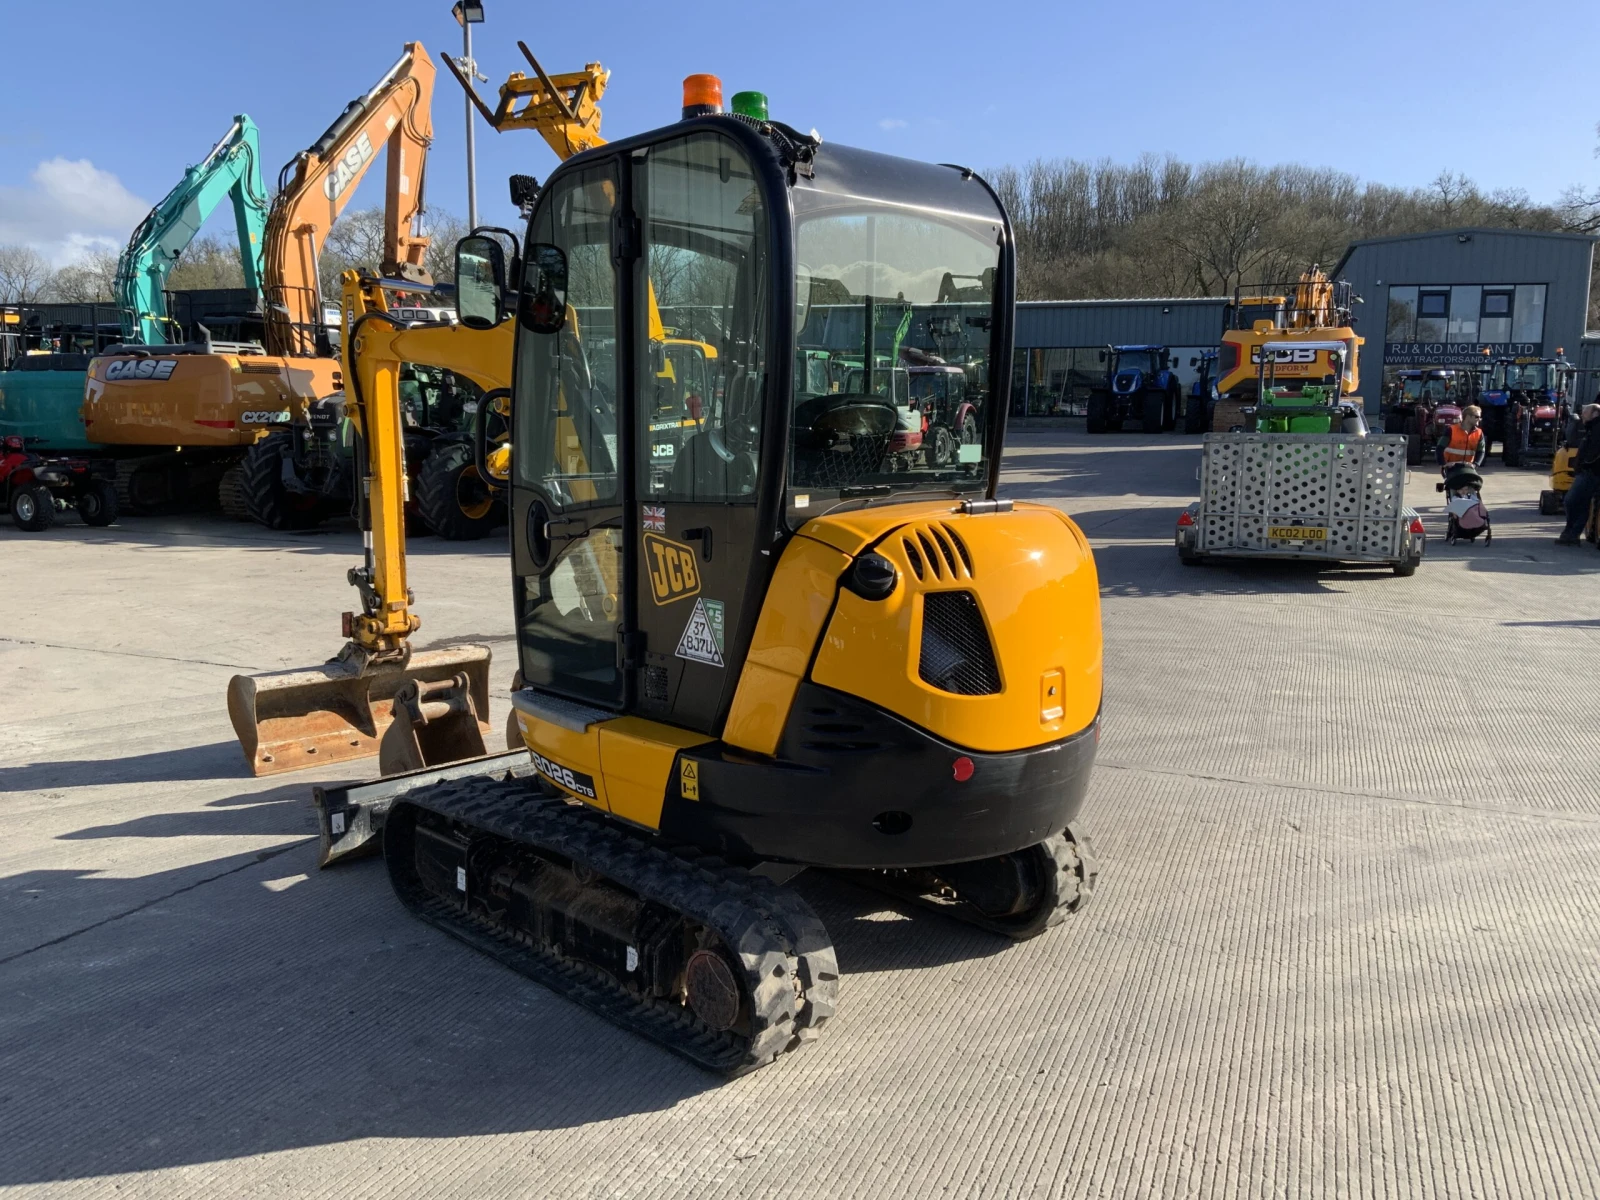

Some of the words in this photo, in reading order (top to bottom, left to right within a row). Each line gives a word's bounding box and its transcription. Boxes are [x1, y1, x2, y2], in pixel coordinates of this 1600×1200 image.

[323, 131, 373, 201] CASE
[1391, 344, 1408, 354] RJ
[1411, 344, 1420, 354] &
[1424, 344, 1443, 354] KD
[1447, 344, 1504, 354] MCLEAN
[1508, 344, 1534, 354] LTD
[105, 360, 178, 380] CASE
[1254, 364, 1309, 375] ODFORM
[241, 411, 291, 423] CX210D
[652, 444, 674, 457] JCB
[1272, 528, 1299, 538] KC02
[651, 541, 696, 598] JCB
[693, 621, 706, 636] 37
[686, 635, 713, 655] BJ7U
